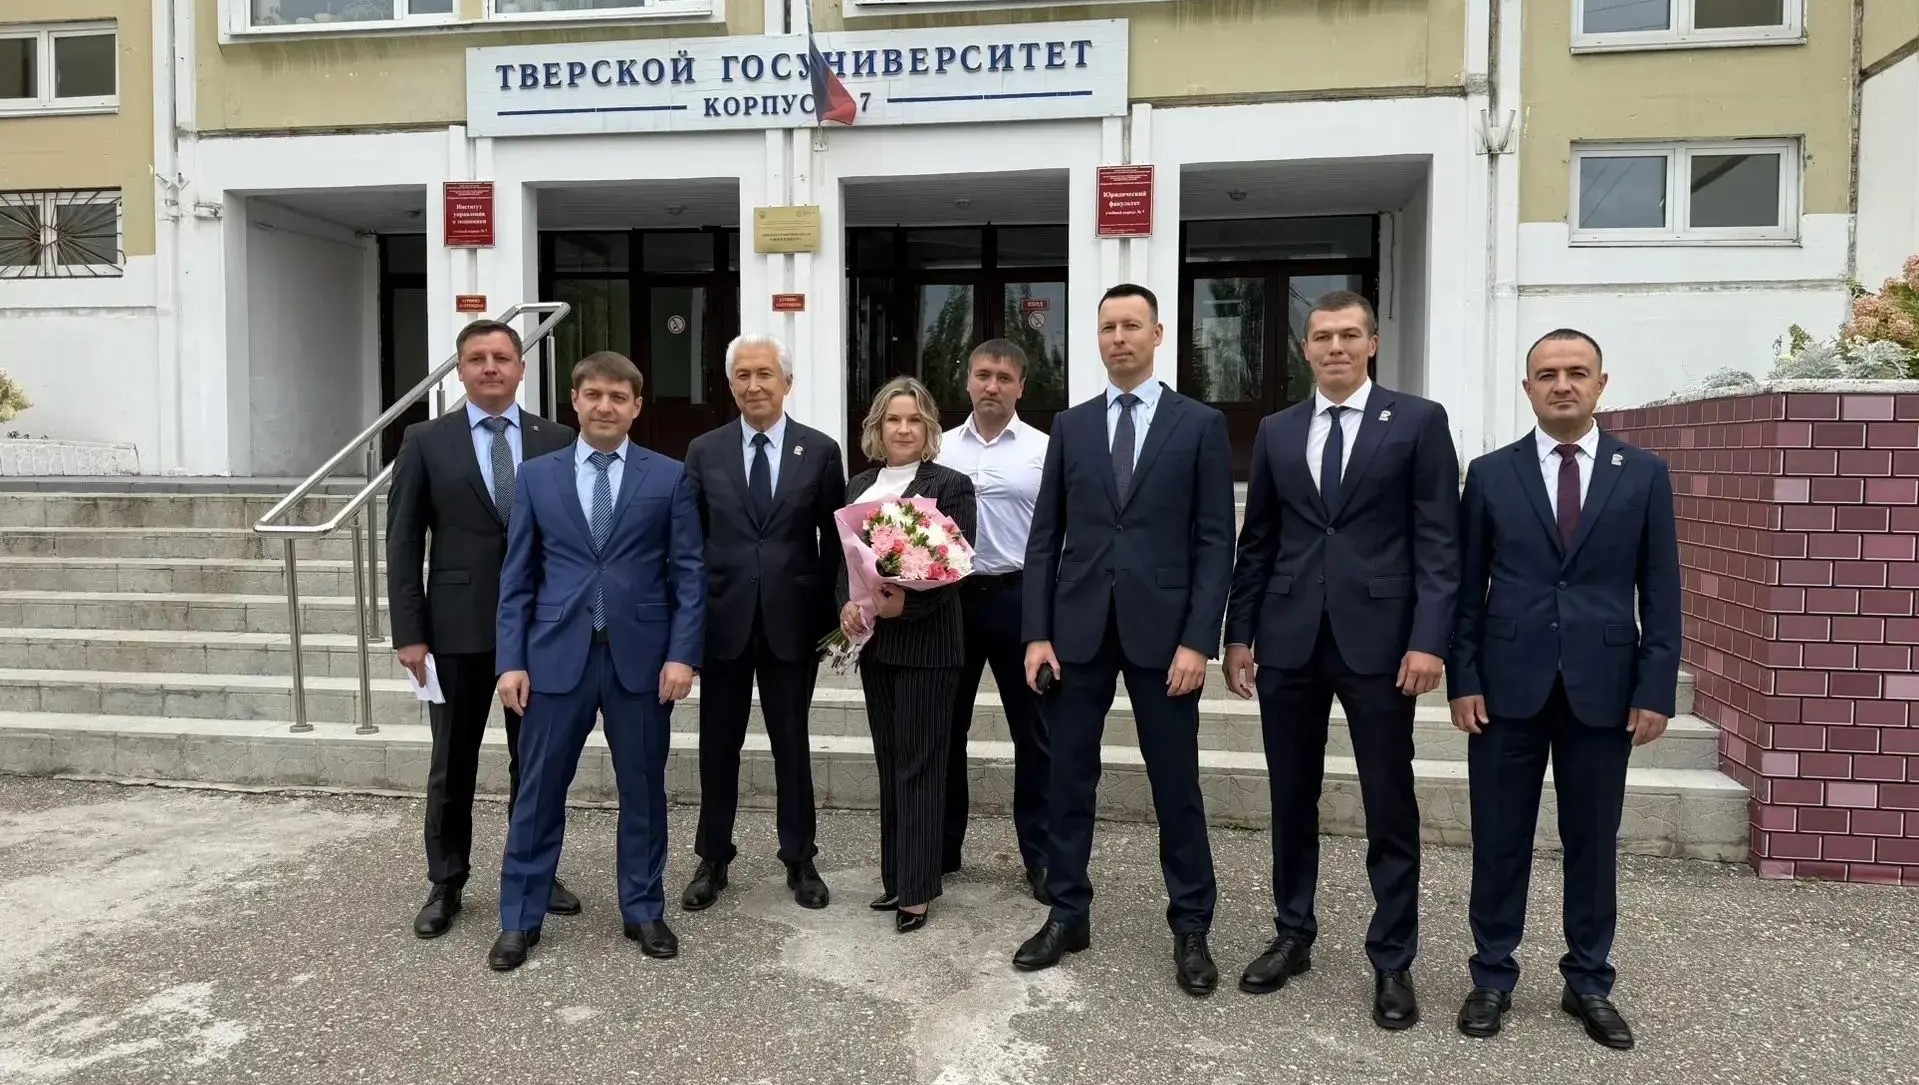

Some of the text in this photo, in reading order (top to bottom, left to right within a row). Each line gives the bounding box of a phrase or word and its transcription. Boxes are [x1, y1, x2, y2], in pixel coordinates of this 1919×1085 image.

[495, 50, 696, 90] ТВЕРСКОЙ
[703, 91, 871, 117] КОРПУС 7
[1103, 190, 1147, 199] Юридический
